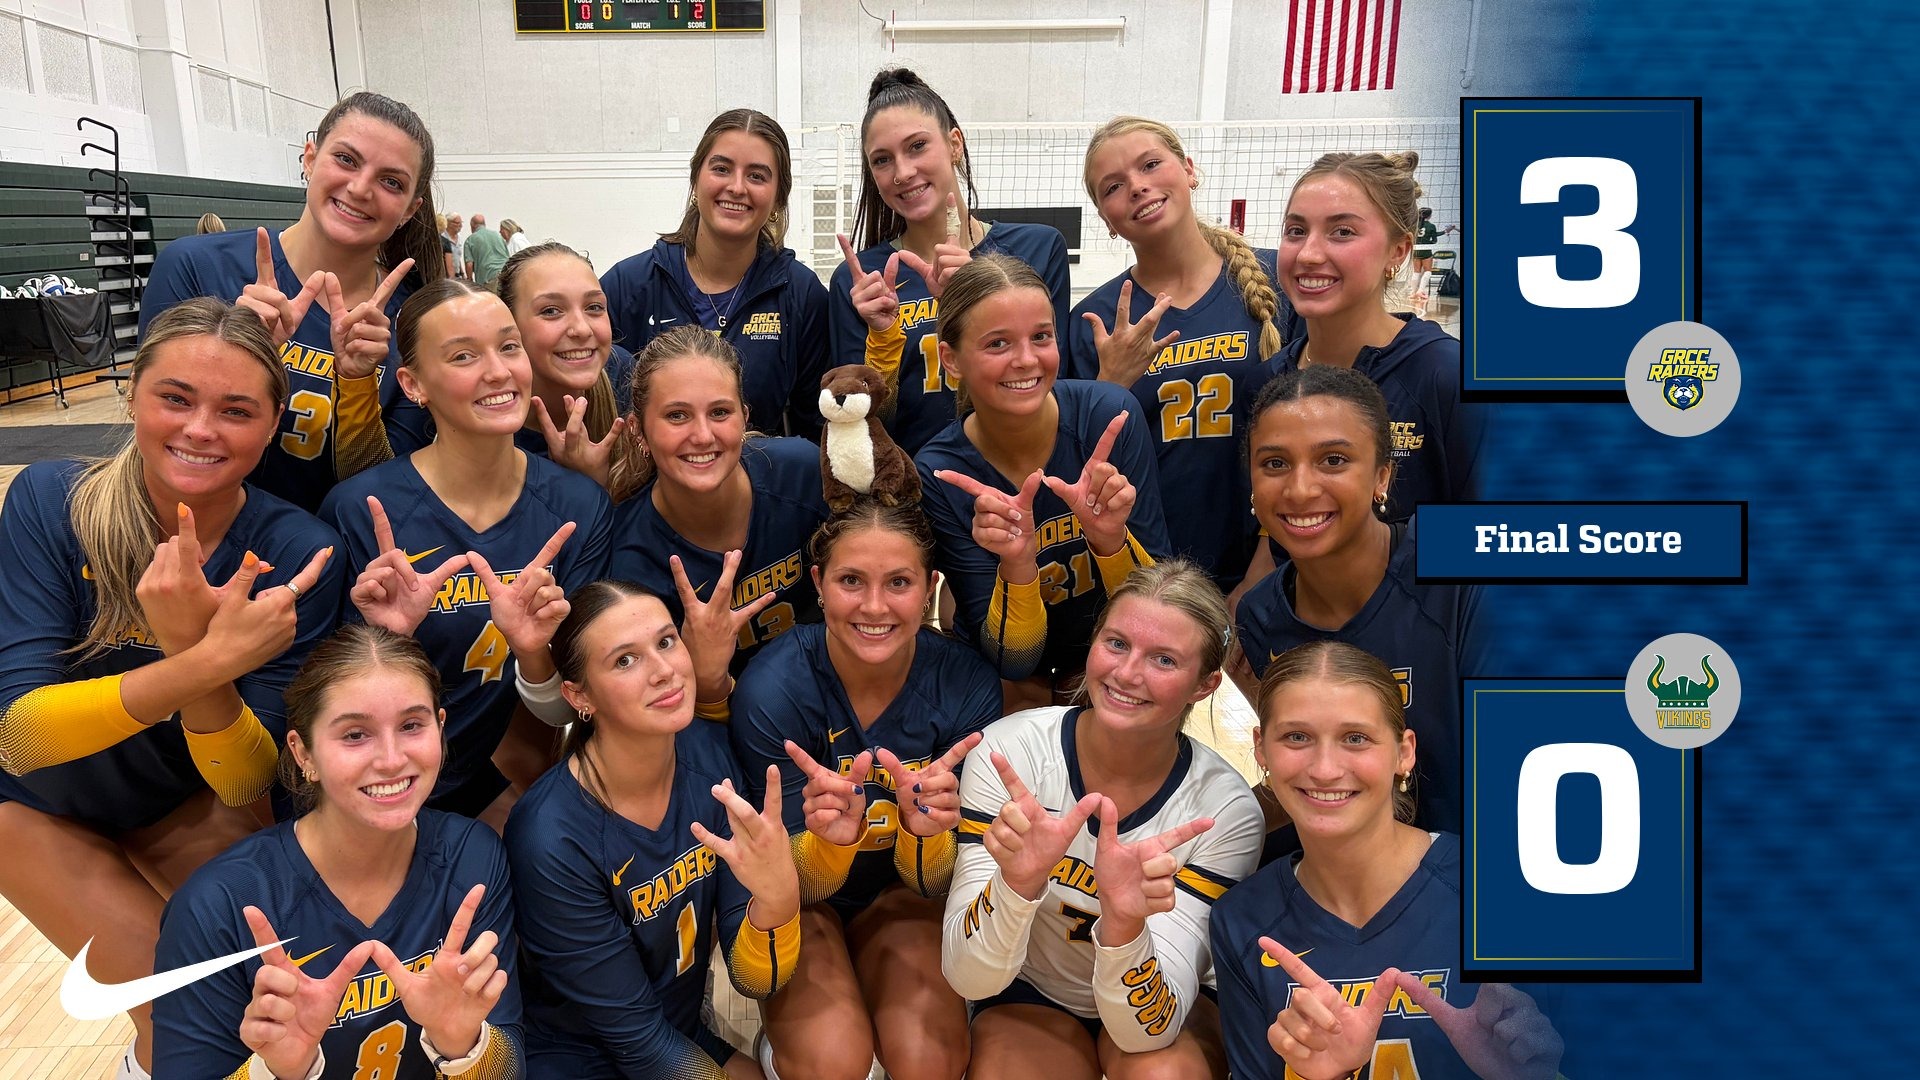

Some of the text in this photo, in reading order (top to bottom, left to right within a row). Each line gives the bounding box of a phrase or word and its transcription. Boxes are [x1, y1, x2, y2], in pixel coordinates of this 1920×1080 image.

[581, 3, 591, 20] 0
[602, 3, 613, 20] 0
[694, 3, 704, 19] 2
[742, 323, 781, 336] RAIDER
[749, 312, 781, 324] GRCC
[280, 389, 333, 461] 3
[1157, 372, 1234, 443] 22
[730, 549, 803, 611] IDERS
[1039, 549, 1096, 606] 21
[463, 619, 511, 686] 4
[676, 899, 698, 978] 1
[1058, 901, 1102, 945] 7
[352, 1019, 407, 1080] 8
